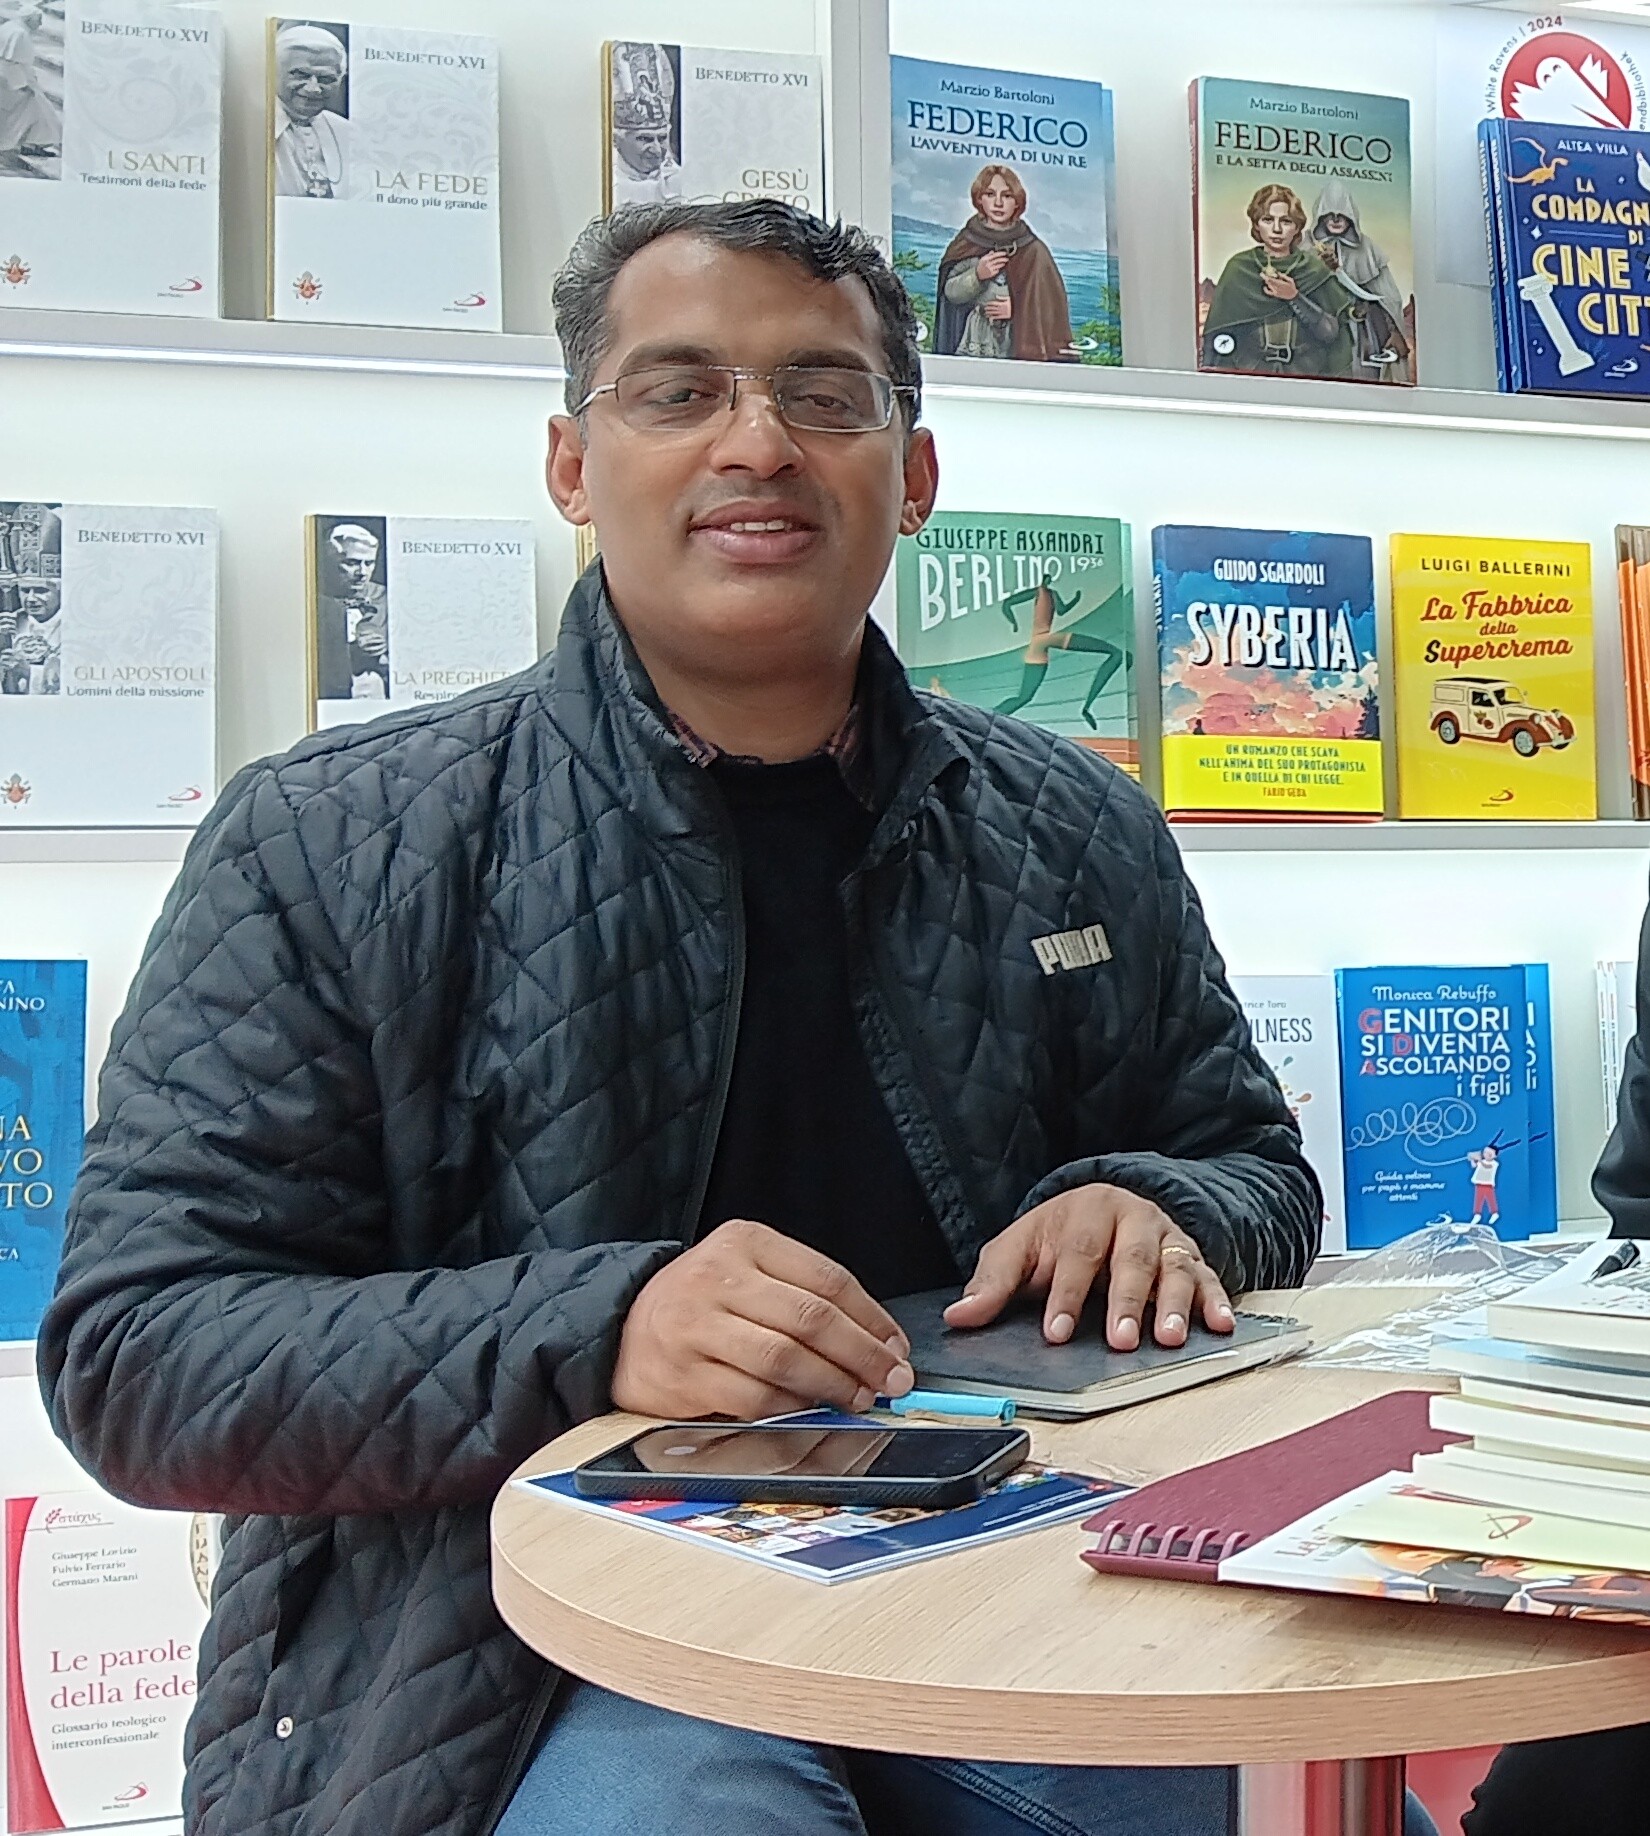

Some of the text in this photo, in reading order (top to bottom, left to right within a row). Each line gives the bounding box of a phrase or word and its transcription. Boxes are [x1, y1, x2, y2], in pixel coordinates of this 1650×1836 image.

[81, 20, 208, 43] BENEDETTO XVI
[1527, 15, 1563, 33] 2024
[364, 47, 485, 70] BENEDETTO XVI
[1488, 36, 1518, 73] Ravens
[695, 66, 808, 87] BENEDETTO XVI
[940, 79, 1055, 105] Marzio Bartoloni
[1484, 76, 1497, 114] White
[1249, 97, 1358, 121] Marzio Bartoloni
[907, 99, 1088, 148] FEDERICO
[911, 135, 1087, 169] L'AVVENTURA DI UN RE
[1214, 120, 1392, 164] FEDERICO
[1557, 139, 1629, 156] ALTEA VILLA
[108, 150, 206, 175] I SANTI
[1216, 154, 1223, 165] E
[1227, 155, 1243, 167] LA
[1247, 157, 1287, 171] SETTA
[1290, 161, 1327, 175] DEGLI
[79, 172, 207, 191] Testimoni della fede
[375, 169, 488, 196] LA FEDE
[742, 168, 809, 191] GESÙ
[1576, 176, 1595, 193] LA
[387, 193, 419, 205] dono
[422, 196, 442, 208] più
[445, 199, 488, 210] grande
[1628, 229, 1644, 246] DI
[1532, 243, 1632, 290] CINE
[1577, 292, 1650, 337] CIT
[78, 529, 204, 546] BENEDETTO XVI
[402, 540, 521, 556] BENEDETTO XVI
[915, 528, 1104, 554] GIUSEPPE ASSANDRI
[1213, 558, 1326, 586] GUIDO SGARDOLI
[1421, 558, 1571, 577] LUIGI BALLERINI
[918, 553, 1062, 632] BERLINO
[1420, 589, 1573, 621] La Fabbrica
[1186, 601, 1359, 672] SYBERIA
[1479, 620, 1519, 636] della
[1424, 638, 1573, 669] Supercrema
[73, 666, 205, 682] GLI APOSTOLI
[393, 670, 418, 686] LA
[66, 685, 205, 698] Uomini della missione
[1226, 744, 1339, 758] UN ROMANZO CHE SCAVA
[1257, 758, 1275, 770] DEL
[1277, 759, 1295, 770] SUO
[1298, 759, 1366, 773] PROTAGONISTA
[1223, 771, 1228, 783] E
[1231, 771, 1242, 783] IN
[1244, 771, 1279, 783] QUELLA
[1295, 772, 1311, 784] CHI
[1030, 923, 1113, 976] PUMA
[1372, 983, 1497, 1003] Monica Rebuffo
[1250, 1017, 1313, 1043] LNESS
[1358, 1006, 1510, 1034] GENITORI
[1360, 1032, 1511, 1057] SI DIVENTA
[1359, 1054, 1511, 1077] ASCOLTANDO
[1456, 1073, 1511, 1105] i figli
[52, 1549, 99, 1561] Giuseppe
[52, 1561, 126, 1574] Fulvio Ferrario
[52, 1573, 138, 1588] Germano Marani
[50, 1639, 193, 1677] Le parole
[50, 1674, 197, 1709] della fede
[51, 1713, 167, 1735] Glossario teologico
[51, 1730, 160, 1751] interconfessionale
